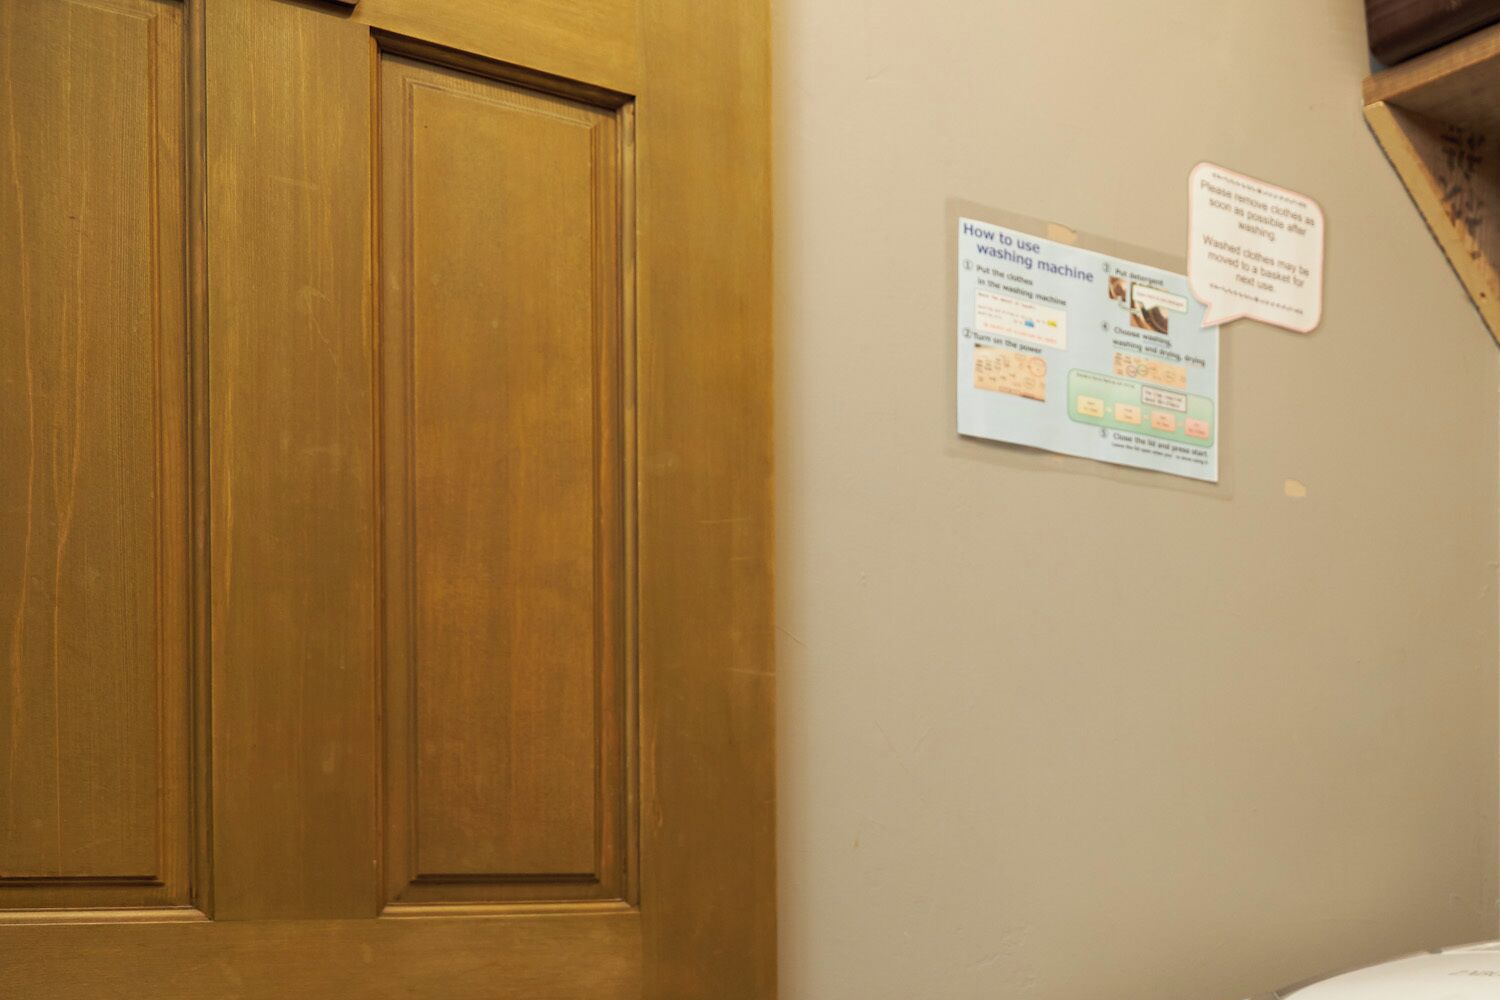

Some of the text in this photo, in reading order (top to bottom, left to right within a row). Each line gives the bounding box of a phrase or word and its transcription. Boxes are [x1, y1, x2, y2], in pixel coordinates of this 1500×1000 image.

[1200, 179, 1315, 226] Please remove clothes as
[1209, 198, 1306, 236] soon as possible after
[963, 222, 1041, 255] How to use
[1203, 234, 1241, 255] Washed
[1242, 248, 1275, 266] clothes
[1277, 259, 1296, 274] may
[976, 243, 1094, 283] washing machine
[976, 264, 991, 275] Put
[992, 267, 1005, 279] the
[1006, 272, 1033, 286] clothes
[1207, 251, 1239, 268] moved
[1003, 284, 1033, 299] washing
